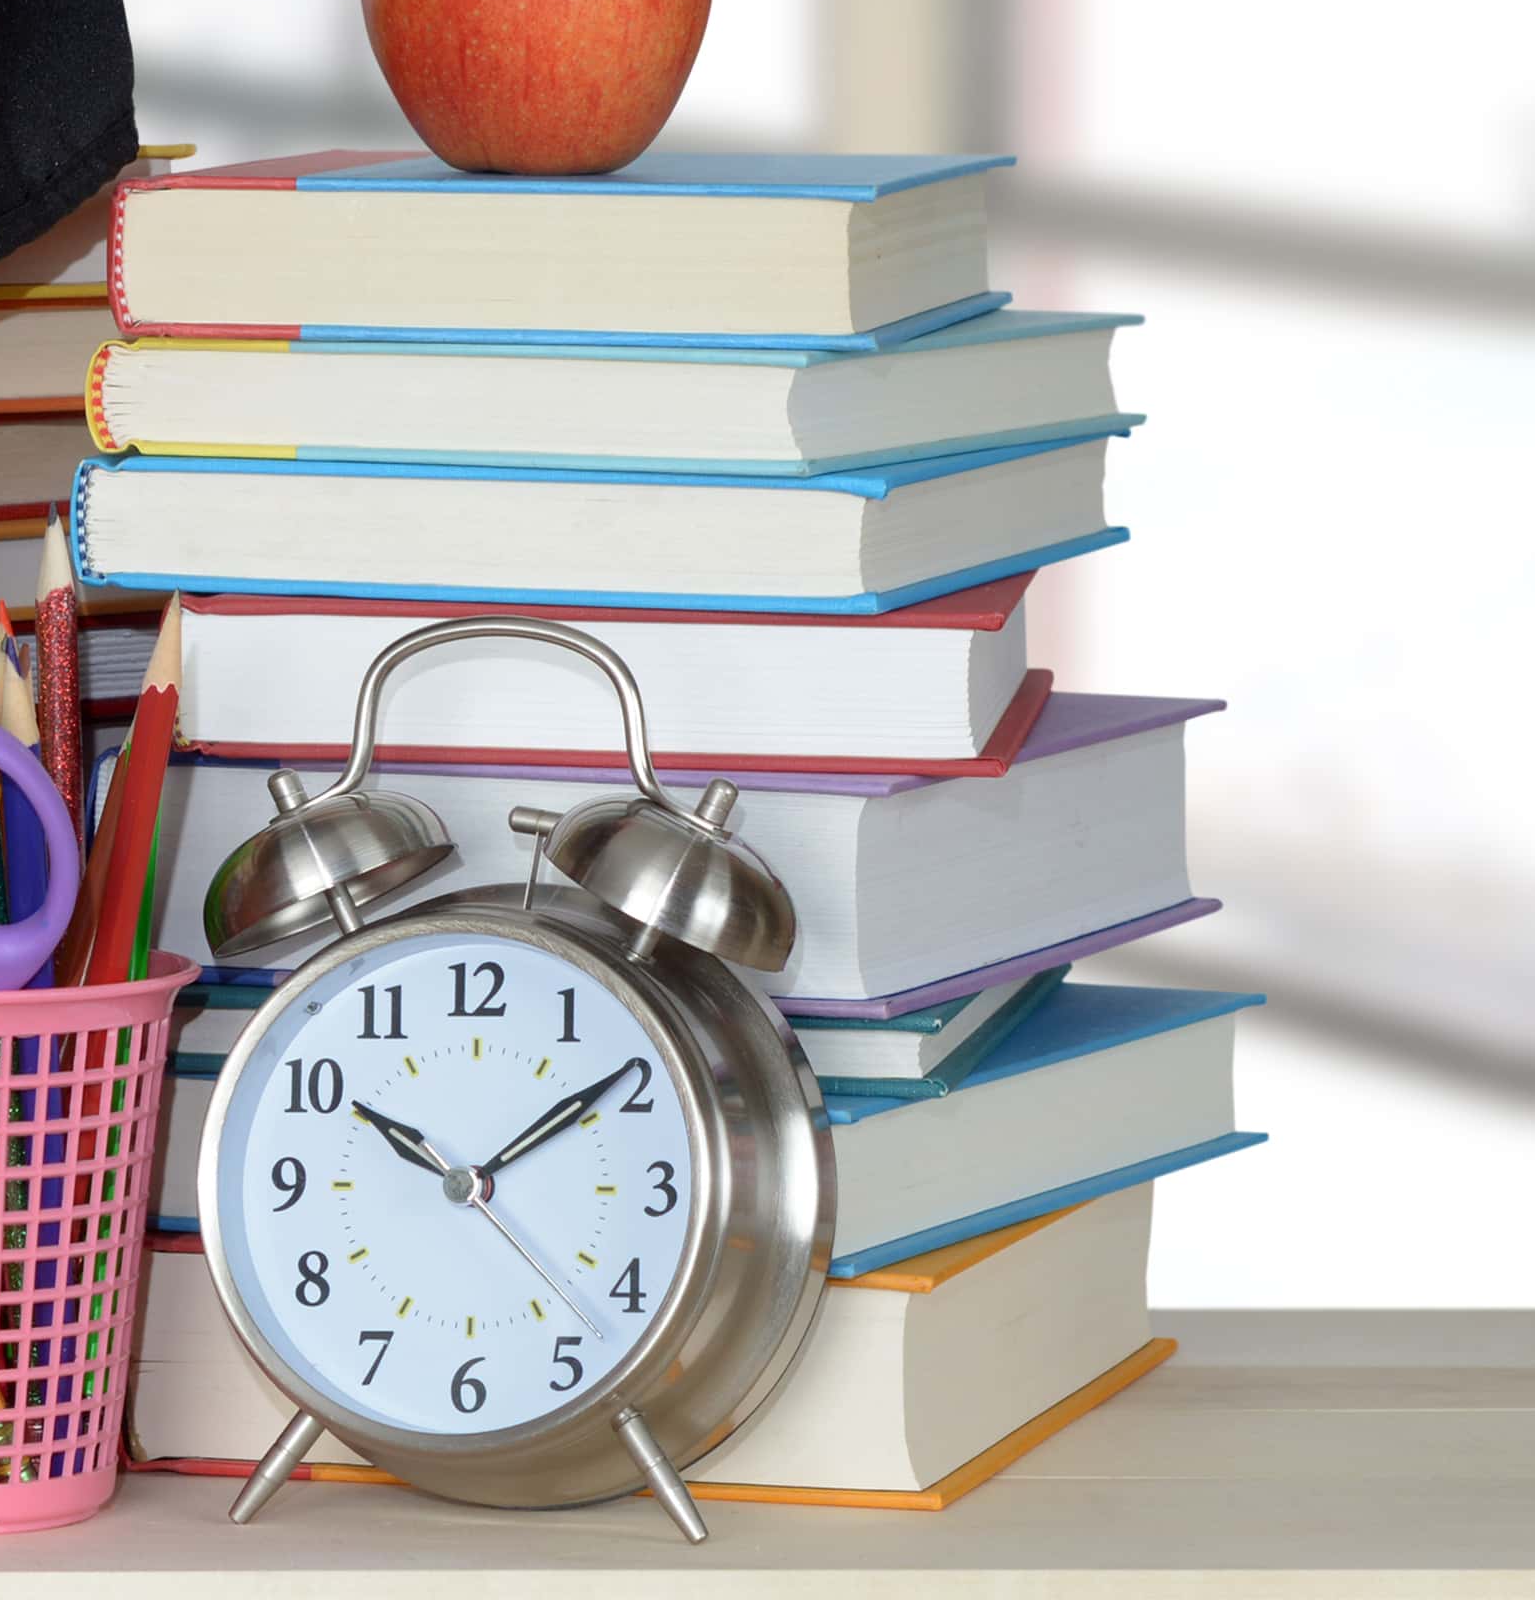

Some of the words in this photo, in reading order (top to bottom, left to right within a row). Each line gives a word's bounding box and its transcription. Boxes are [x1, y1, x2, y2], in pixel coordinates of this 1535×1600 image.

[357, 984, 408, 1040] 11
[447, 961, 507, 1017] 12
[556, 987, 581, 1043] 1
[284, 1058, 344, 1114] 10
[619, 1056, 654, 1113] 2
[271, 1156, 307, 1213] 9
[643, 1160, 678, 1218] 3
[295, 1250, 330, 1307] 8
[609, 1257, 647, 1313] 4
[358, 1330, 394, 1386] 7
[450, 1356, 487, 1414] 6
[549, 1336, 584, 1392] 5
